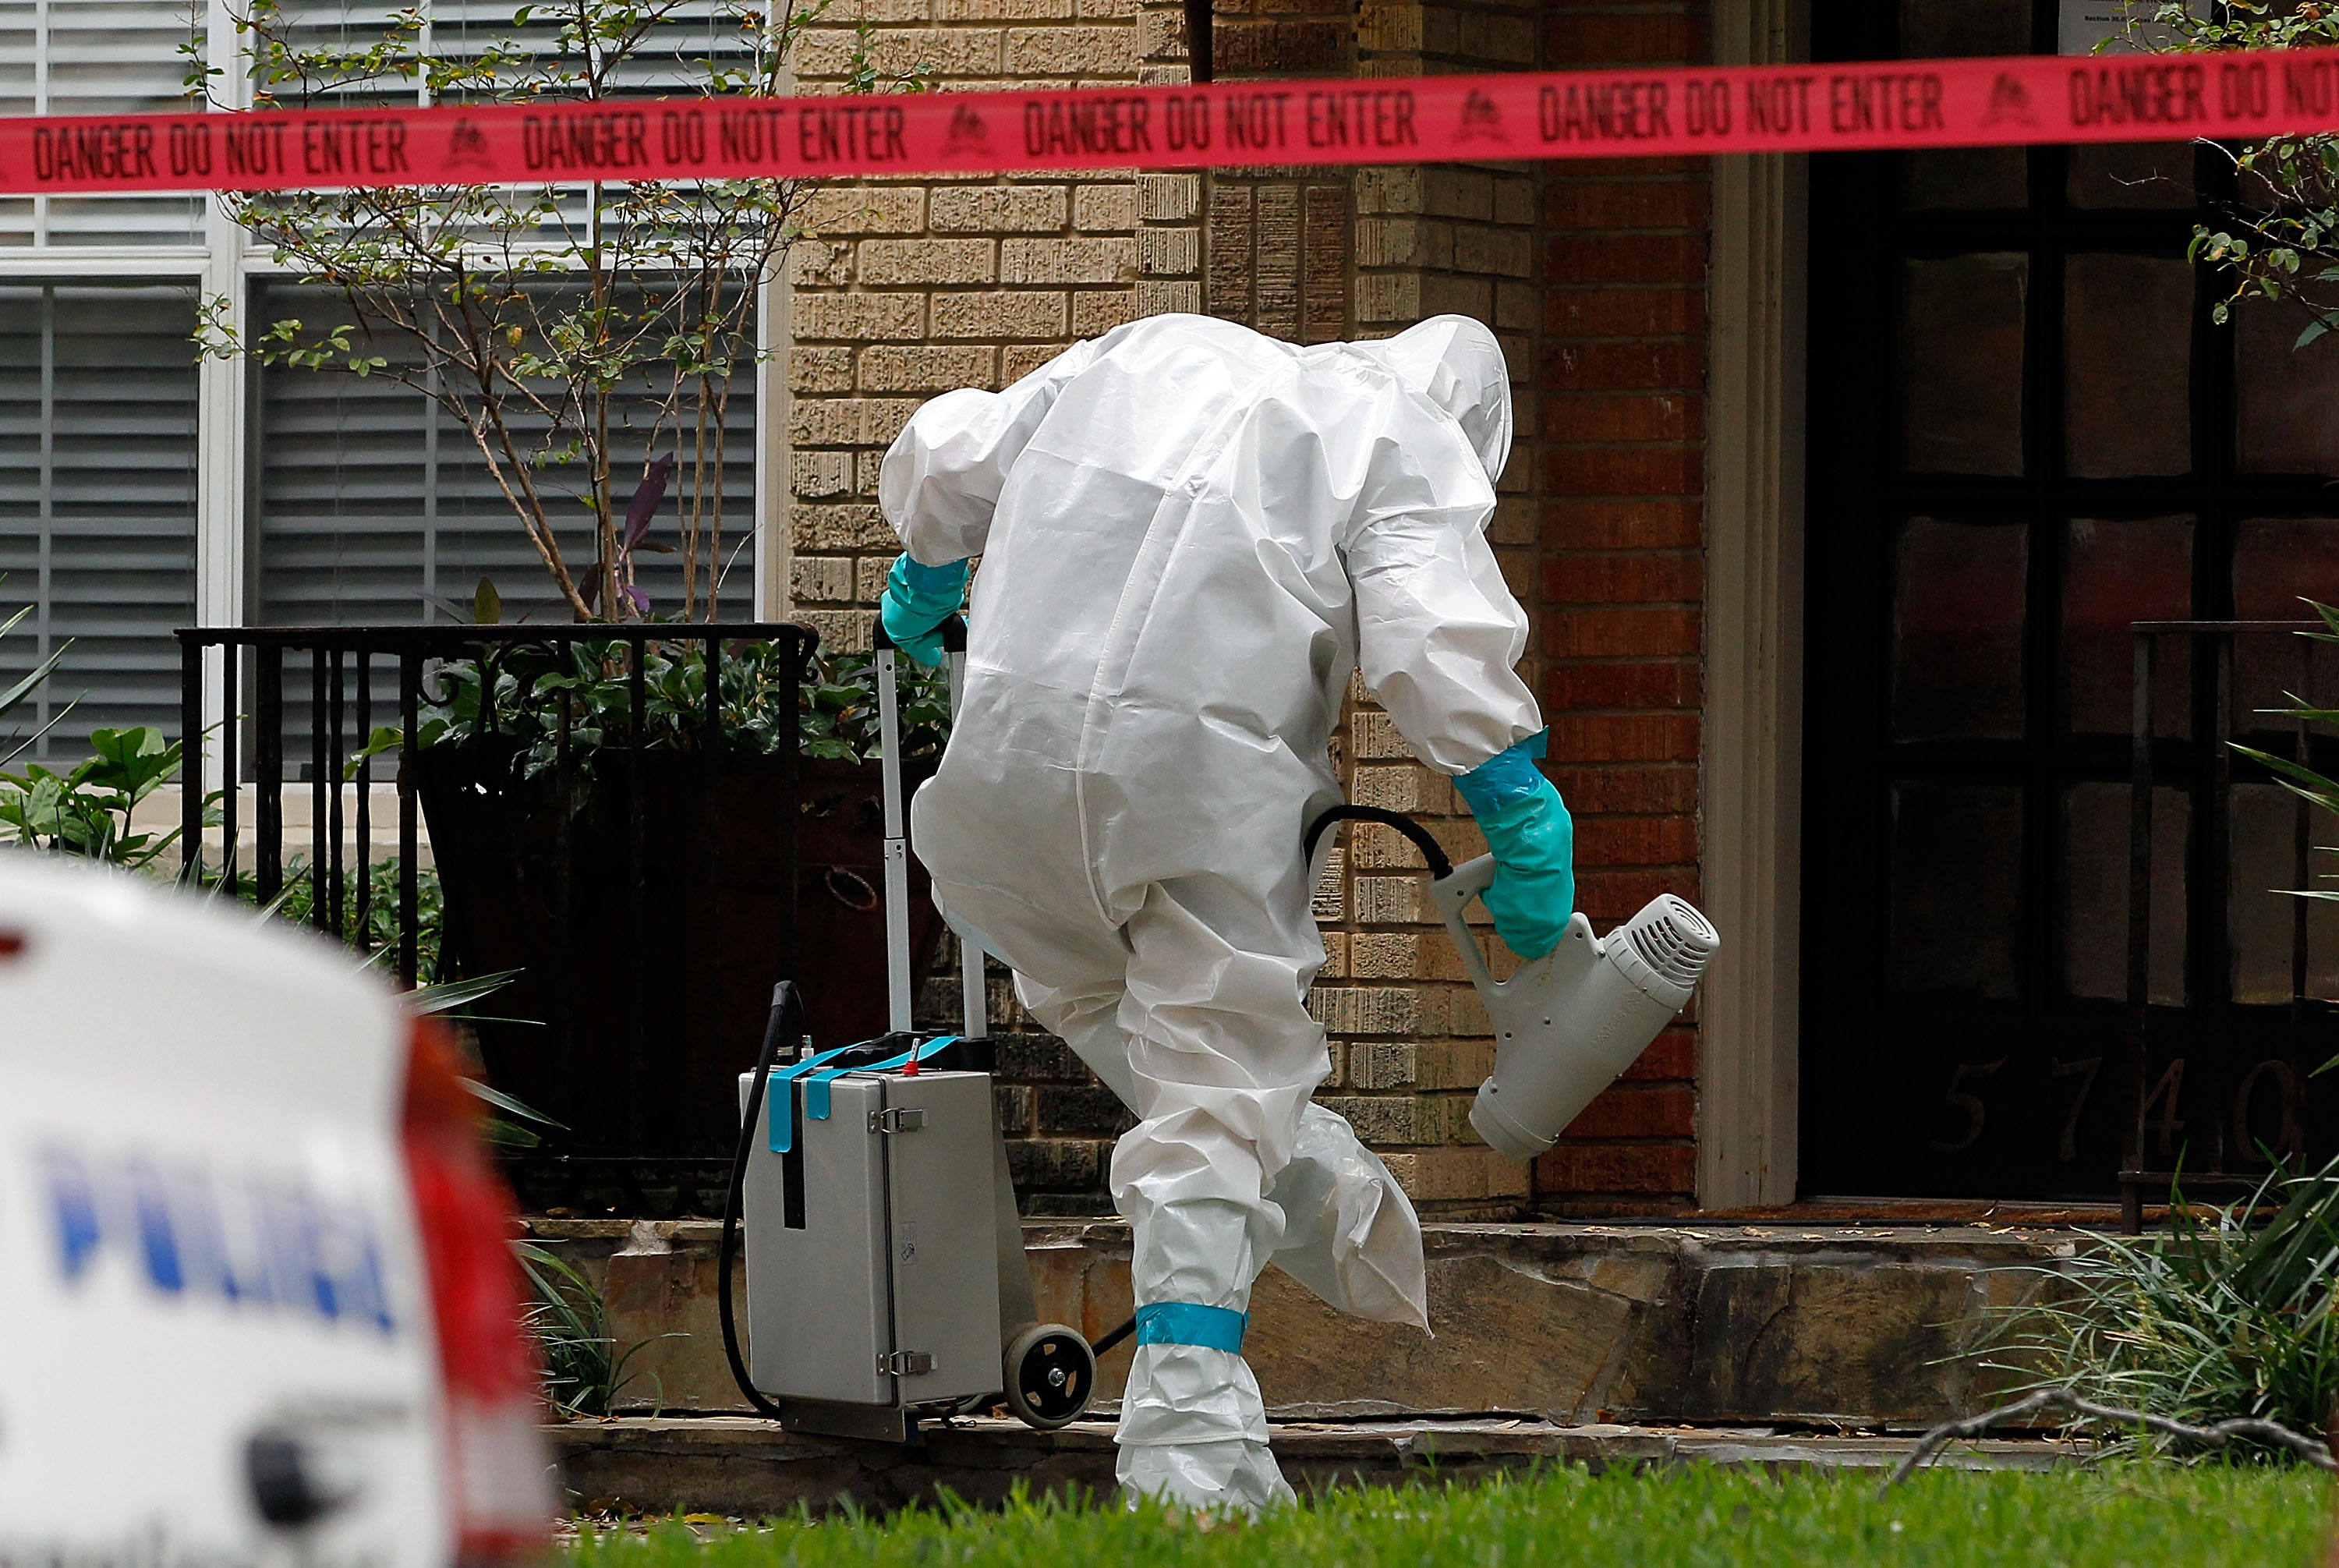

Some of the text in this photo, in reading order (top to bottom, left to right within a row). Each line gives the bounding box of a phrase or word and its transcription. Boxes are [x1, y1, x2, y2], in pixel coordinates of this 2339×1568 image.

[1023, 90, 1419, 156] DANGER DO NOT ENTER
[1538, 73, 1944, 141] DANGER DO NOT ENTER
[2068, 58, 2339, 126] DANGER DO NO
[33, 117, 410, 181] DANGER DO NOT ENTER
[522, 106, 907, 170] DANGER DO NOT ENTER
